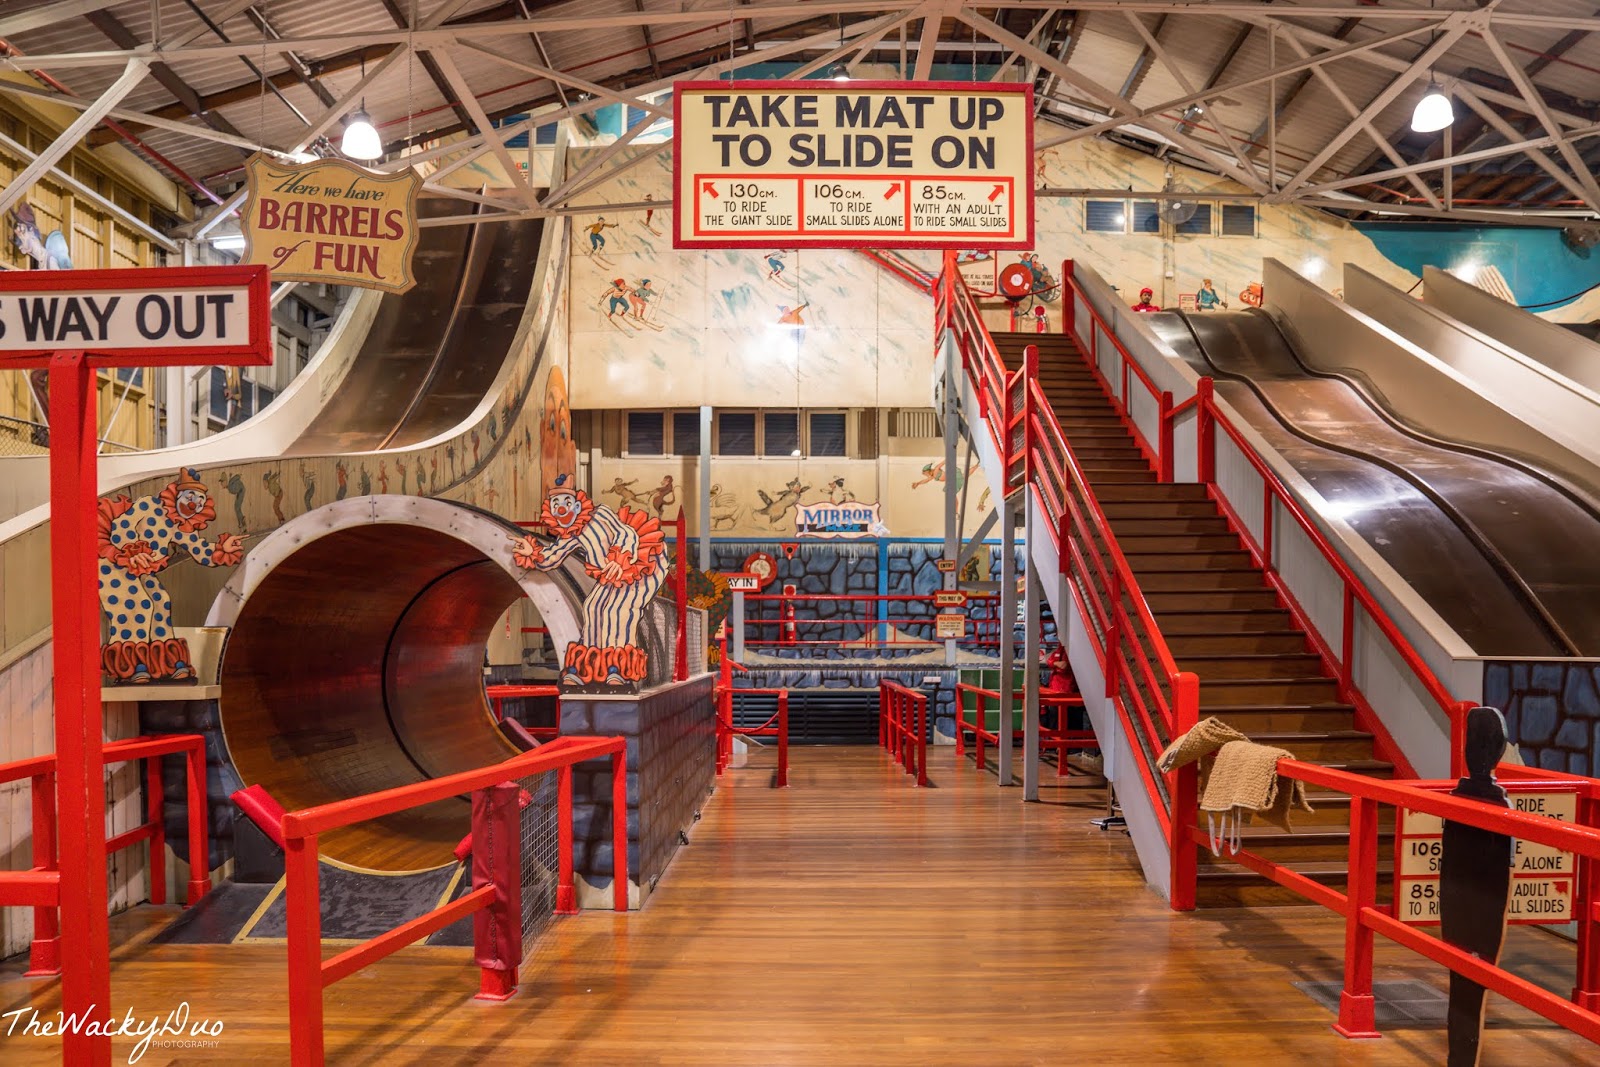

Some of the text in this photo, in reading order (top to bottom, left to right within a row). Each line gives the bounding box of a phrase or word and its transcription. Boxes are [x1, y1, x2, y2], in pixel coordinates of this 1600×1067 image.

[703, 95, 1005, 130] TAKE MAT UP
[712, 133, 995, 169] TO SLIDE ON
[267, 170, 385, 201] Here we have
[723, 201, 767, 213] TO RIDE
[830, 201, 872, 213] TO RIDE
[913, 203, 1003, 215] WITH AN ADULT
[257, 198, 405, 241] BARRELS
[704, 215, 793, 226] THE GIANT SLIDE
[806, 215, 904, 226] SMALL SLIDES ALONE
[914, 216, 1007, 227] TO RIDE SMALL SLIDES
[270, 239, 386, 280] of FUN
[18, 296, 121, 342] WAY
[135, 293, 234, 340] OUT
[803, 509, 873, 527] MIRROR
[825, 524, 861, 532] MAZE
[727, 577, 753, 587] AY IN
[1516, 798, 1545, 812] RIDE
[1521, 856, 1563, 870] ALONE
[1513, 883, 1549, 896] ADULT
[1408, 901, 1422, 915] TO
[1429, 901, 1440, 915] RI
[1526, 899, 1565, 913] SLIDES
